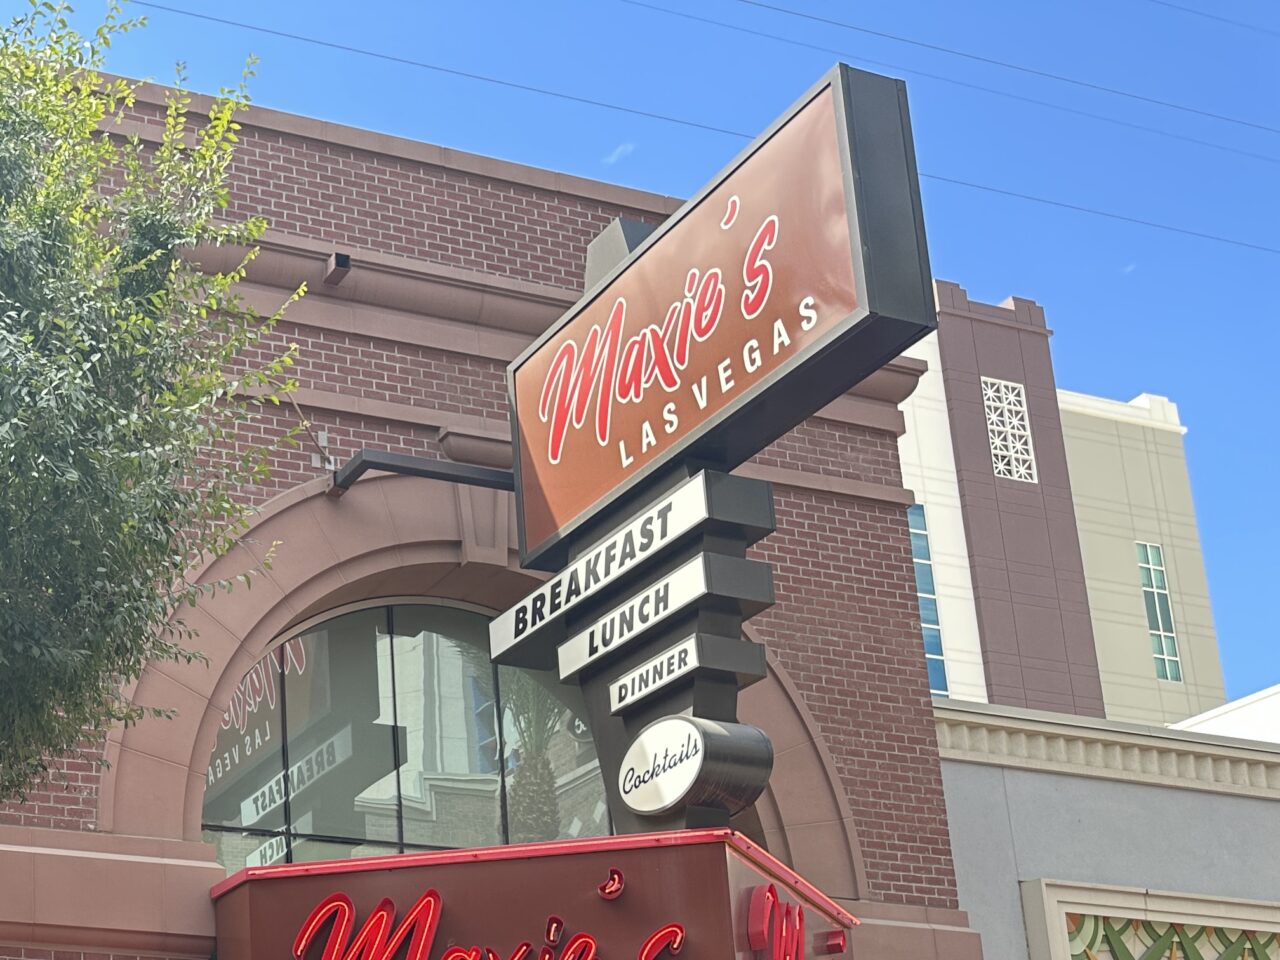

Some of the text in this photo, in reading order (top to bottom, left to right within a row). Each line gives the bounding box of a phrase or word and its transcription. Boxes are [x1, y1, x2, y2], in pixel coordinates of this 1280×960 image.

[539, 195, 779, 465] Maxie's
[619, 295, 818, 469] LAS VEGAS
[513, 501, 673, 640] BREAKFAST
[587, 582, 670, 658] LUNCH
[617, 647, 689, 704] DINNER
[622, 733, 700, 795] Cocktails
